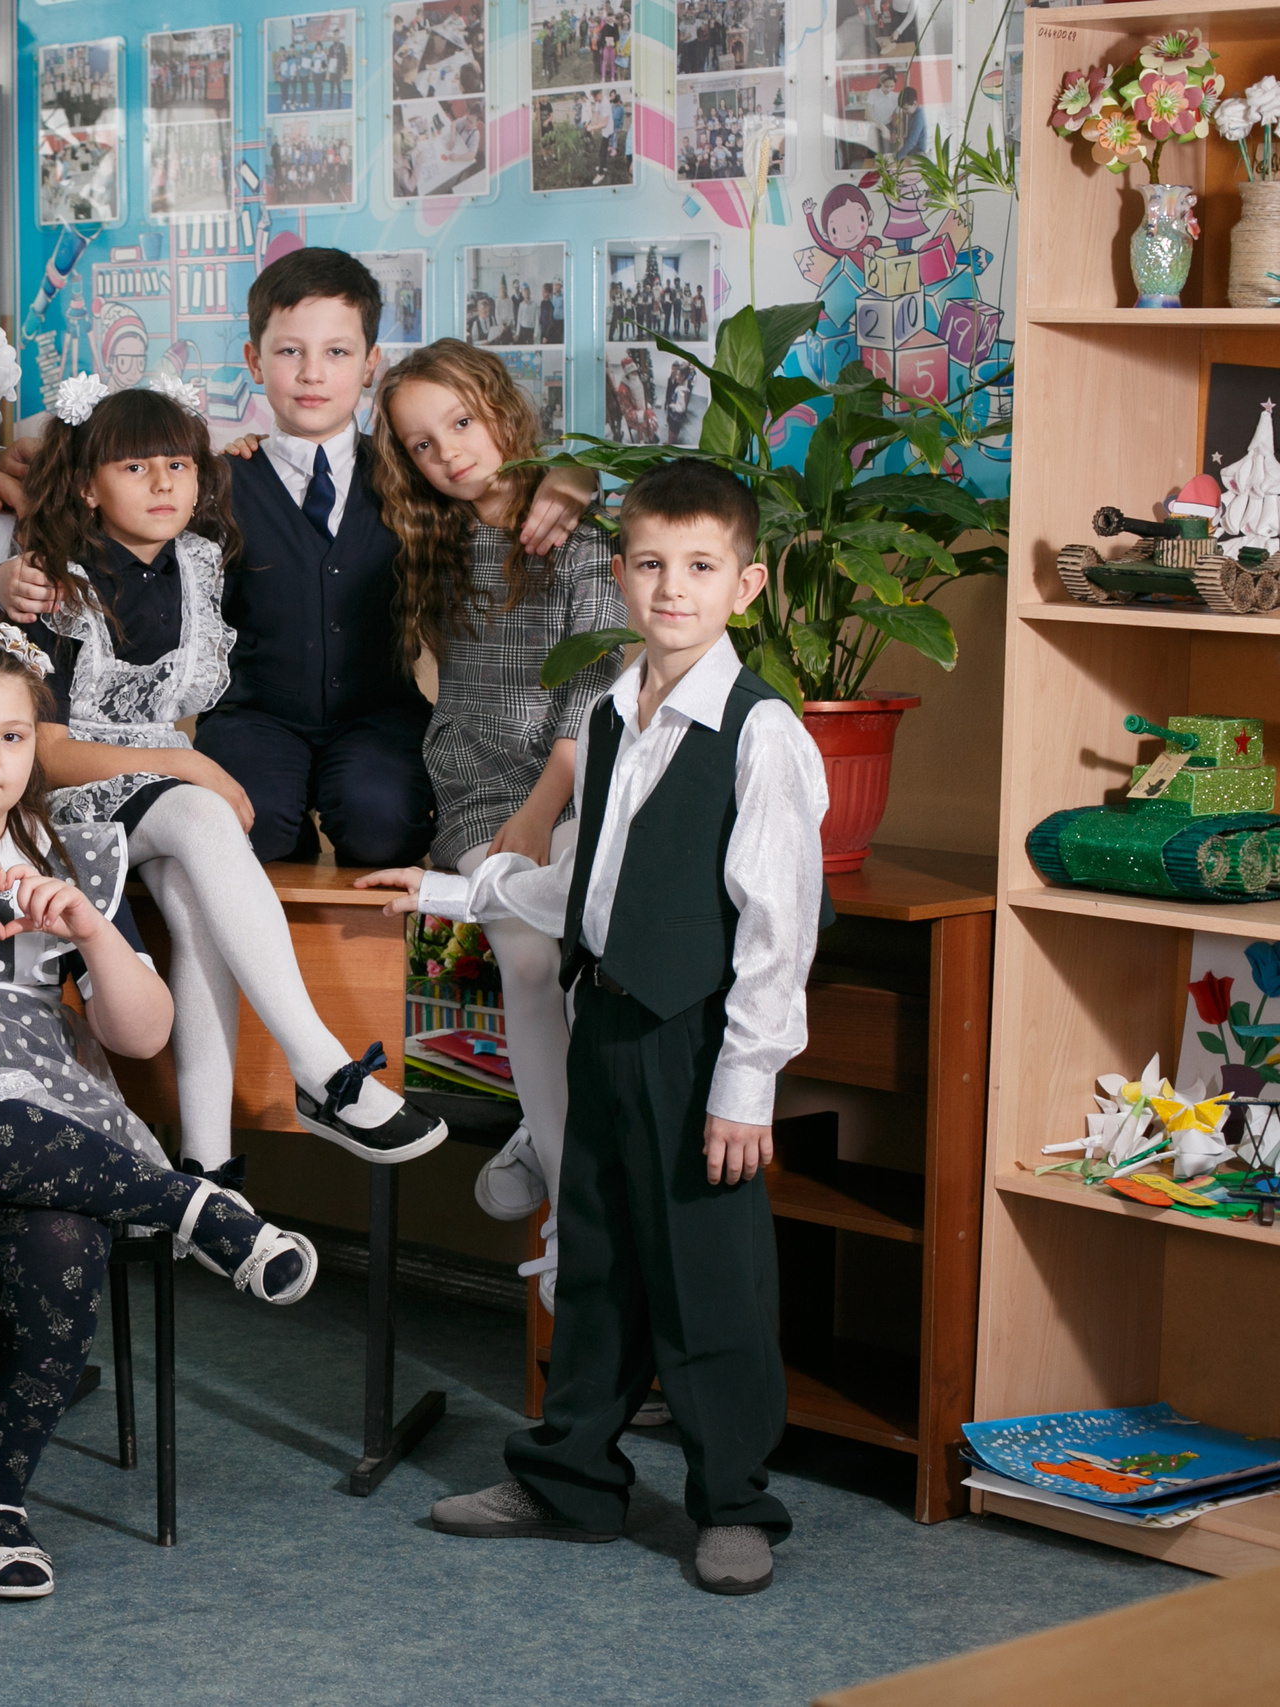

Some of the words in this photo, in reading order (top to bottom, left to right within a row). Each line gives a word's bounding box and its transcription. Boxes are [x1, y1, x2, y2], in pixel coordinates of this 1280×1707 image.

[867, 257, 880, 289] 8
[894, 261, 912, 292] 7
[864, 309, 886, 340] 2
[901, 295, 918, 335] 10
[945, 315, 972, 352] 19
[977, 322, 998, 352] 20
[912, 359, 935, 399] 5
